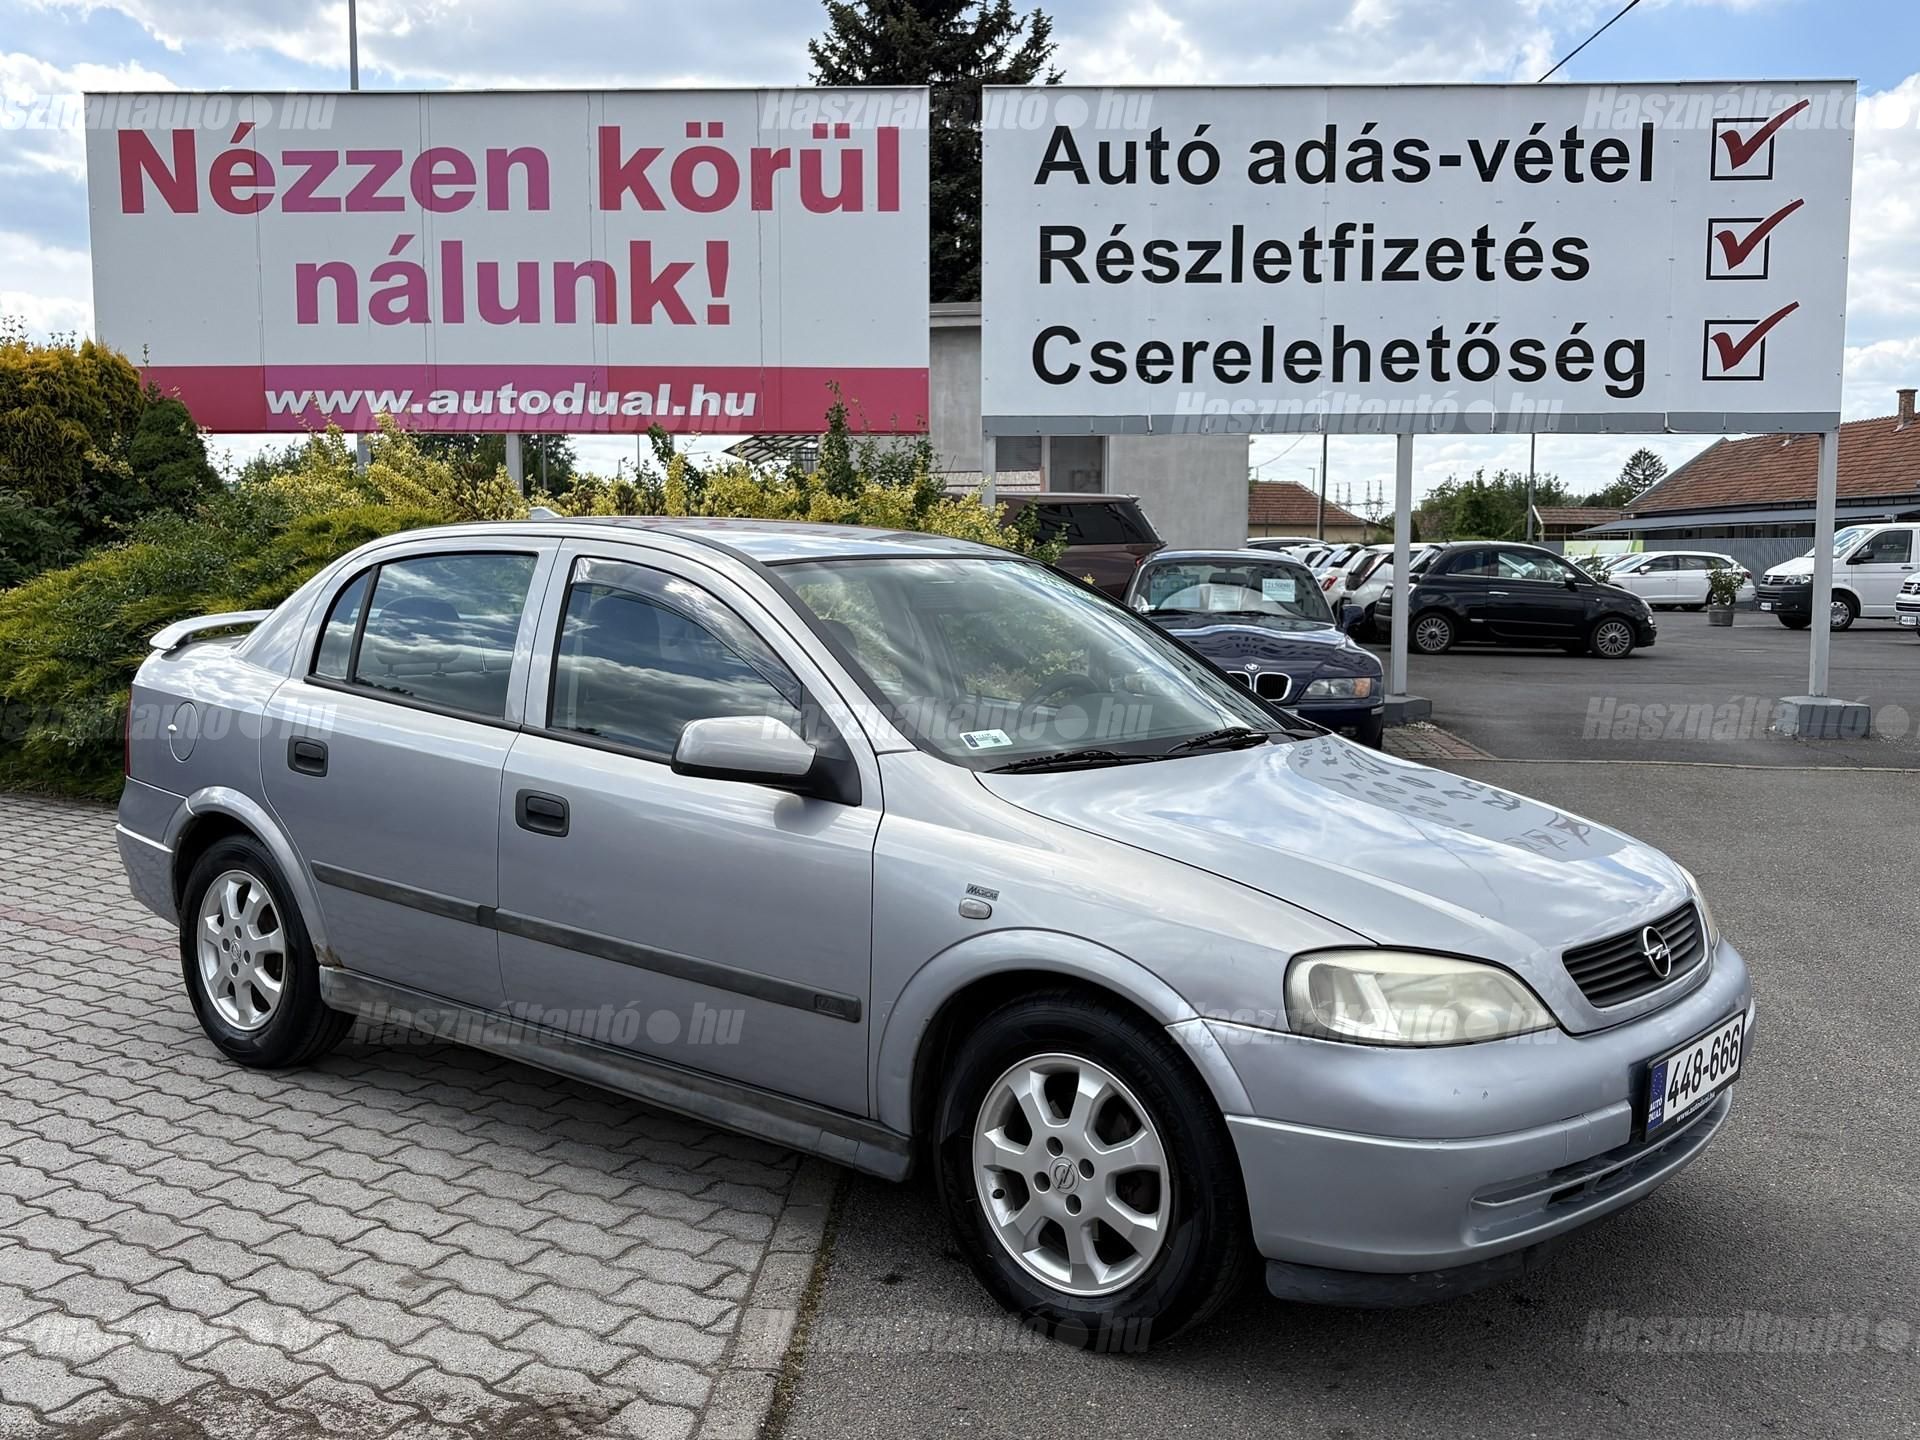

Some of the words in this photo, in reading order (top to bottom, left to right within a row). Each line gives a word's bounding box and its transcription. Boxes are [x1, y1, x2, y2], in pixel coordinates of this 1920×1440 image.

[120, 123, 549, 213] Nézzen
[600, 122, 899, 212] körül
[1034, 124, 1221, 185] Autó
[1247, 122, 1654, 184] adás-vétel
[296, 235, 729, 325] nálunk!
[1040, 222, 1590, 284] Részletfizetés
[1033, 322, 1645, 398] Cserelehetőség
[265, 383, 756, 418] www.autodual.hu
[1667, 1023, 1740, 1108] 448-666
